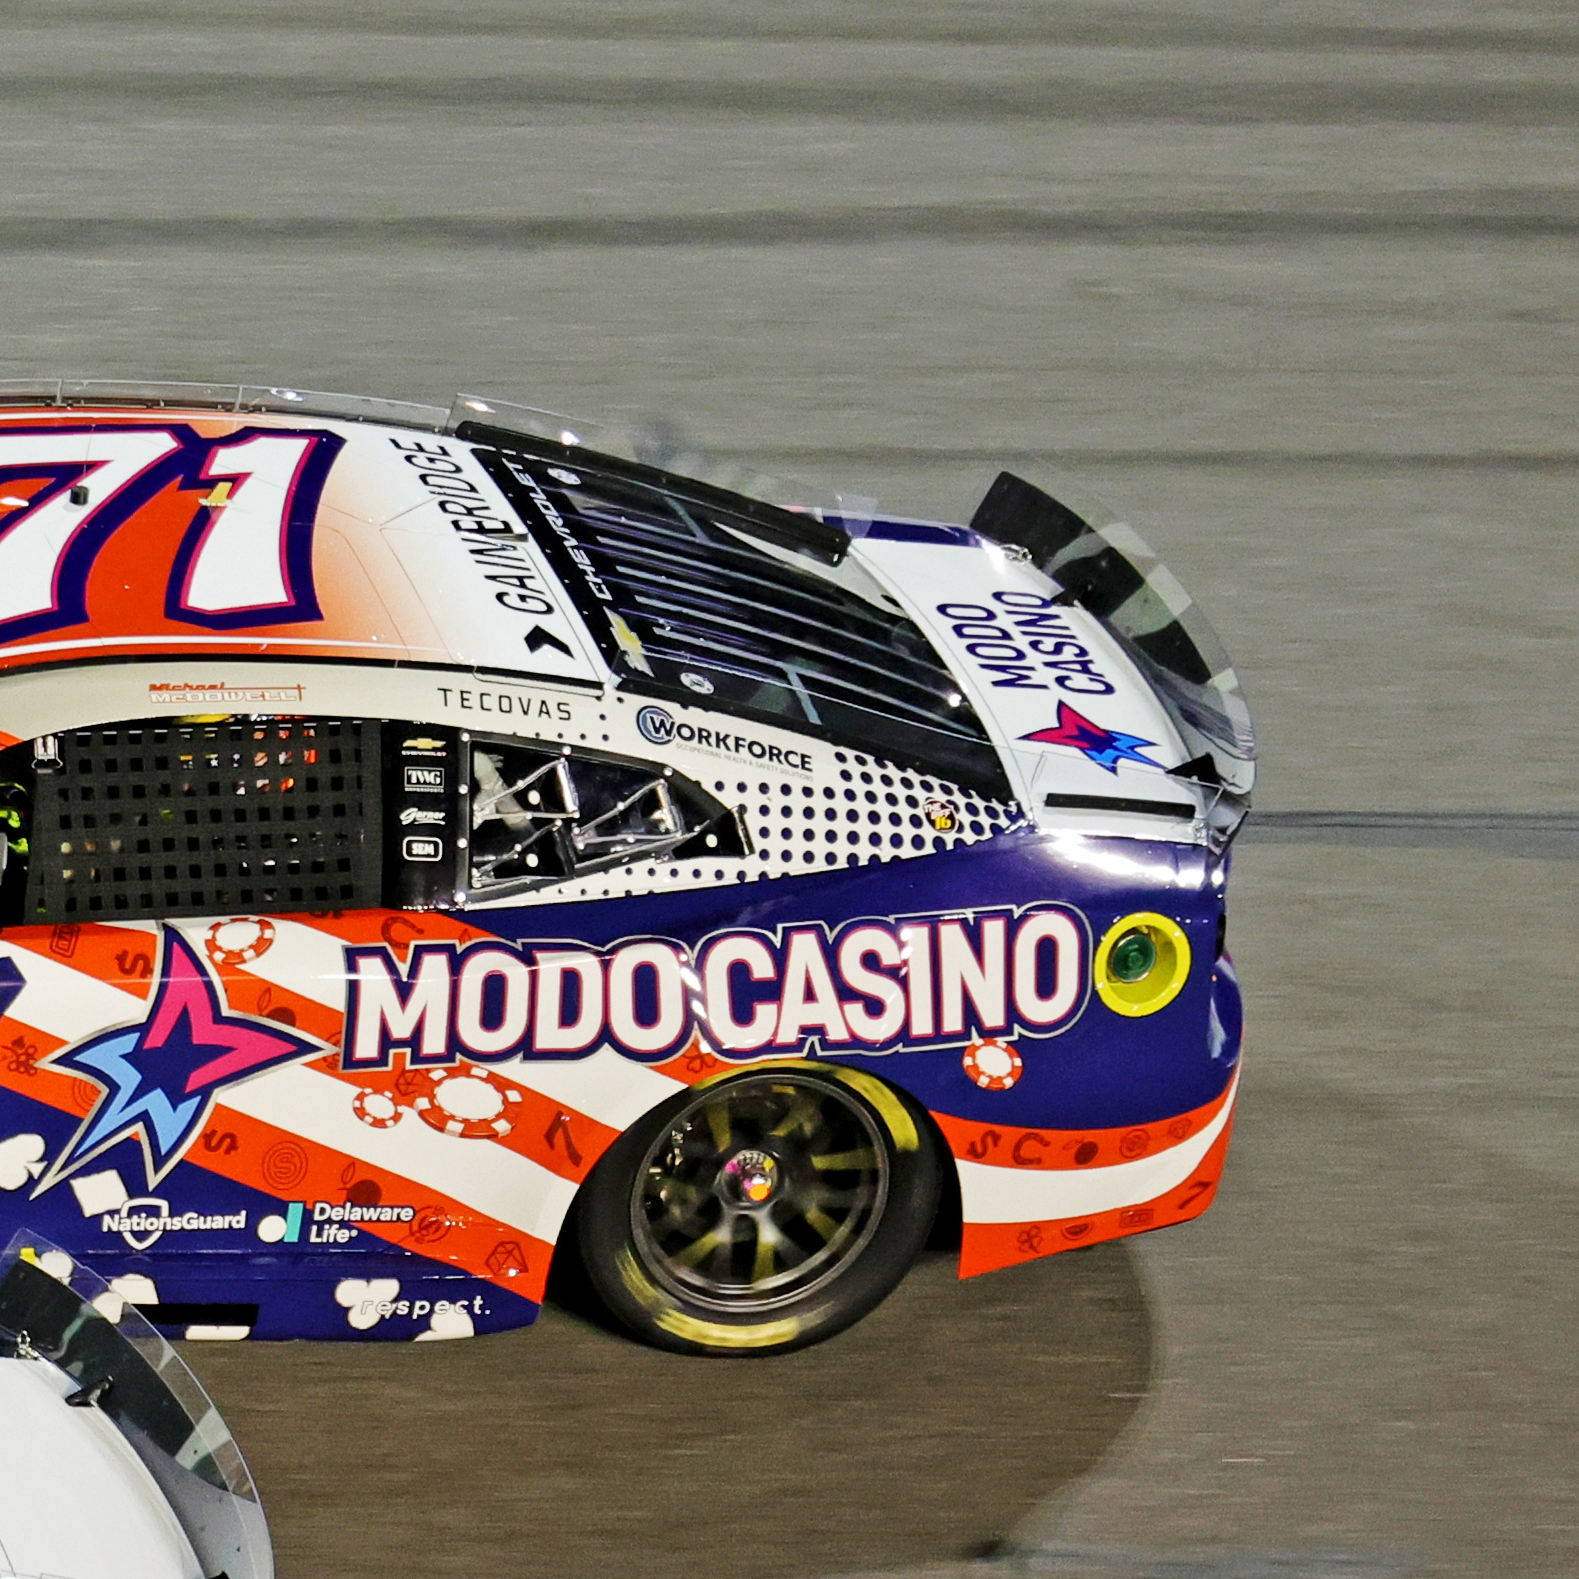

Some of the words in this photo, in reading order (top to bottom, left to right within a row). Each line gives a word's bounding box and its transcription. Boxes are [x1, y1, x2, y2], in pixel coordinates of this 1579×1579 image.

[502, 457, 613, 601] CHEVROLET
[936, 603, 1051, 690] MODO
[992, 591, 1116, 696] CASINO
[149, 681, 226, 691] Michael
[437, 687, 572, 721] TECOVAS
[647, 713, 814, 773] WORKFORCE
[407, 770, 441, 785] TWG
[934, 816, 952, 830] 16
[411, 842, 435, 855] SEM
[102, 1210, 247, 1233] NationsGuard
[314, 1202, 414, 1222] Delaware
[361, 1297, 492, 1320] respect.
